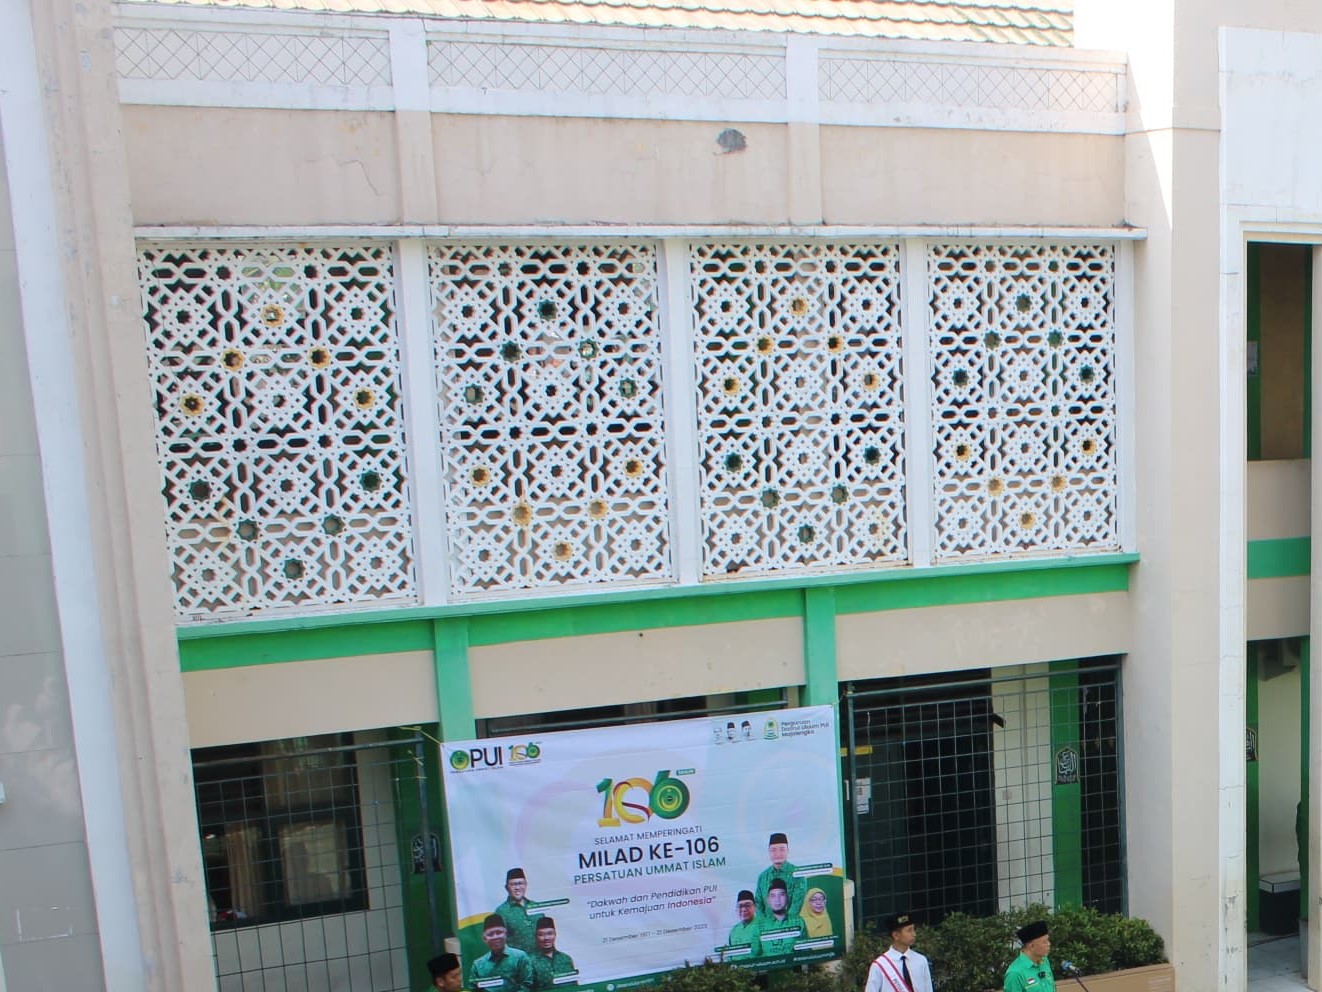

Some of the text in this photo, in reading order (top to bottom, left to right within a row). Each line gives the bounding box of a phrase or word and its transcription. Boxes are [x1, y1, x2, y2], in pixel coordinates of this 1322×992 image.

[470, 746, 503, 768] PUI
[596, 769, 691, 828] 106
[594, 825, 703, 846] SELAMAT MEMPERINGATI
[578, 836, 720, 869] MILAD KE-106
[574, 857, 726, 885] PERSATUAN UMMAT ISLAM
[630, 895, 649, 903] dan
[650, 888, 701, 900] Pendidikan
[703, 885, 718, 894] PUI
[589, 910, 615, 920] untuk
[618, 903, 665, 915] Kemajuan
